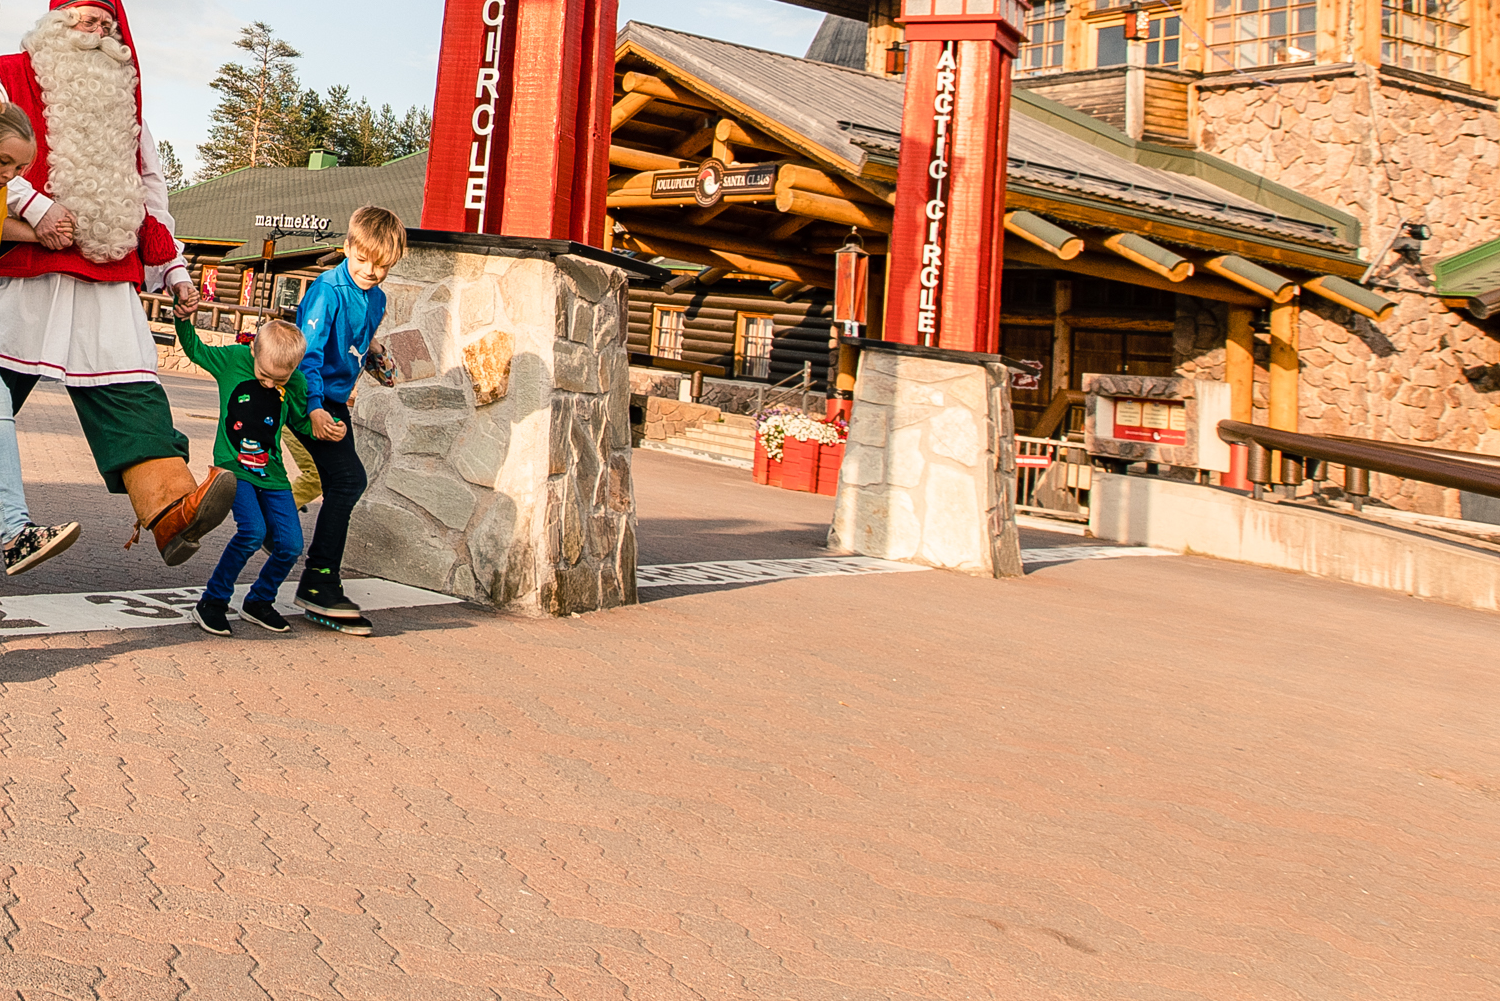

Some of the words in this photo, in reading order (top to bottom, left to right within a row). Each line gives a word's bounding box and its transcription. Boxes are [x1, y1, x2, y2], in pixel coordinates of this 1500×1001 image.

[928, 50, 957, 180] ARCTIC
[655, 177, 696, 192] JOULUPUKKI
[722, 174, 746, 188] SANTA
[746, 173, 771, 187] CLAUS
[254, 214, 330, 230] marimekko
[916, 199, 946, 335] CIRCLE
